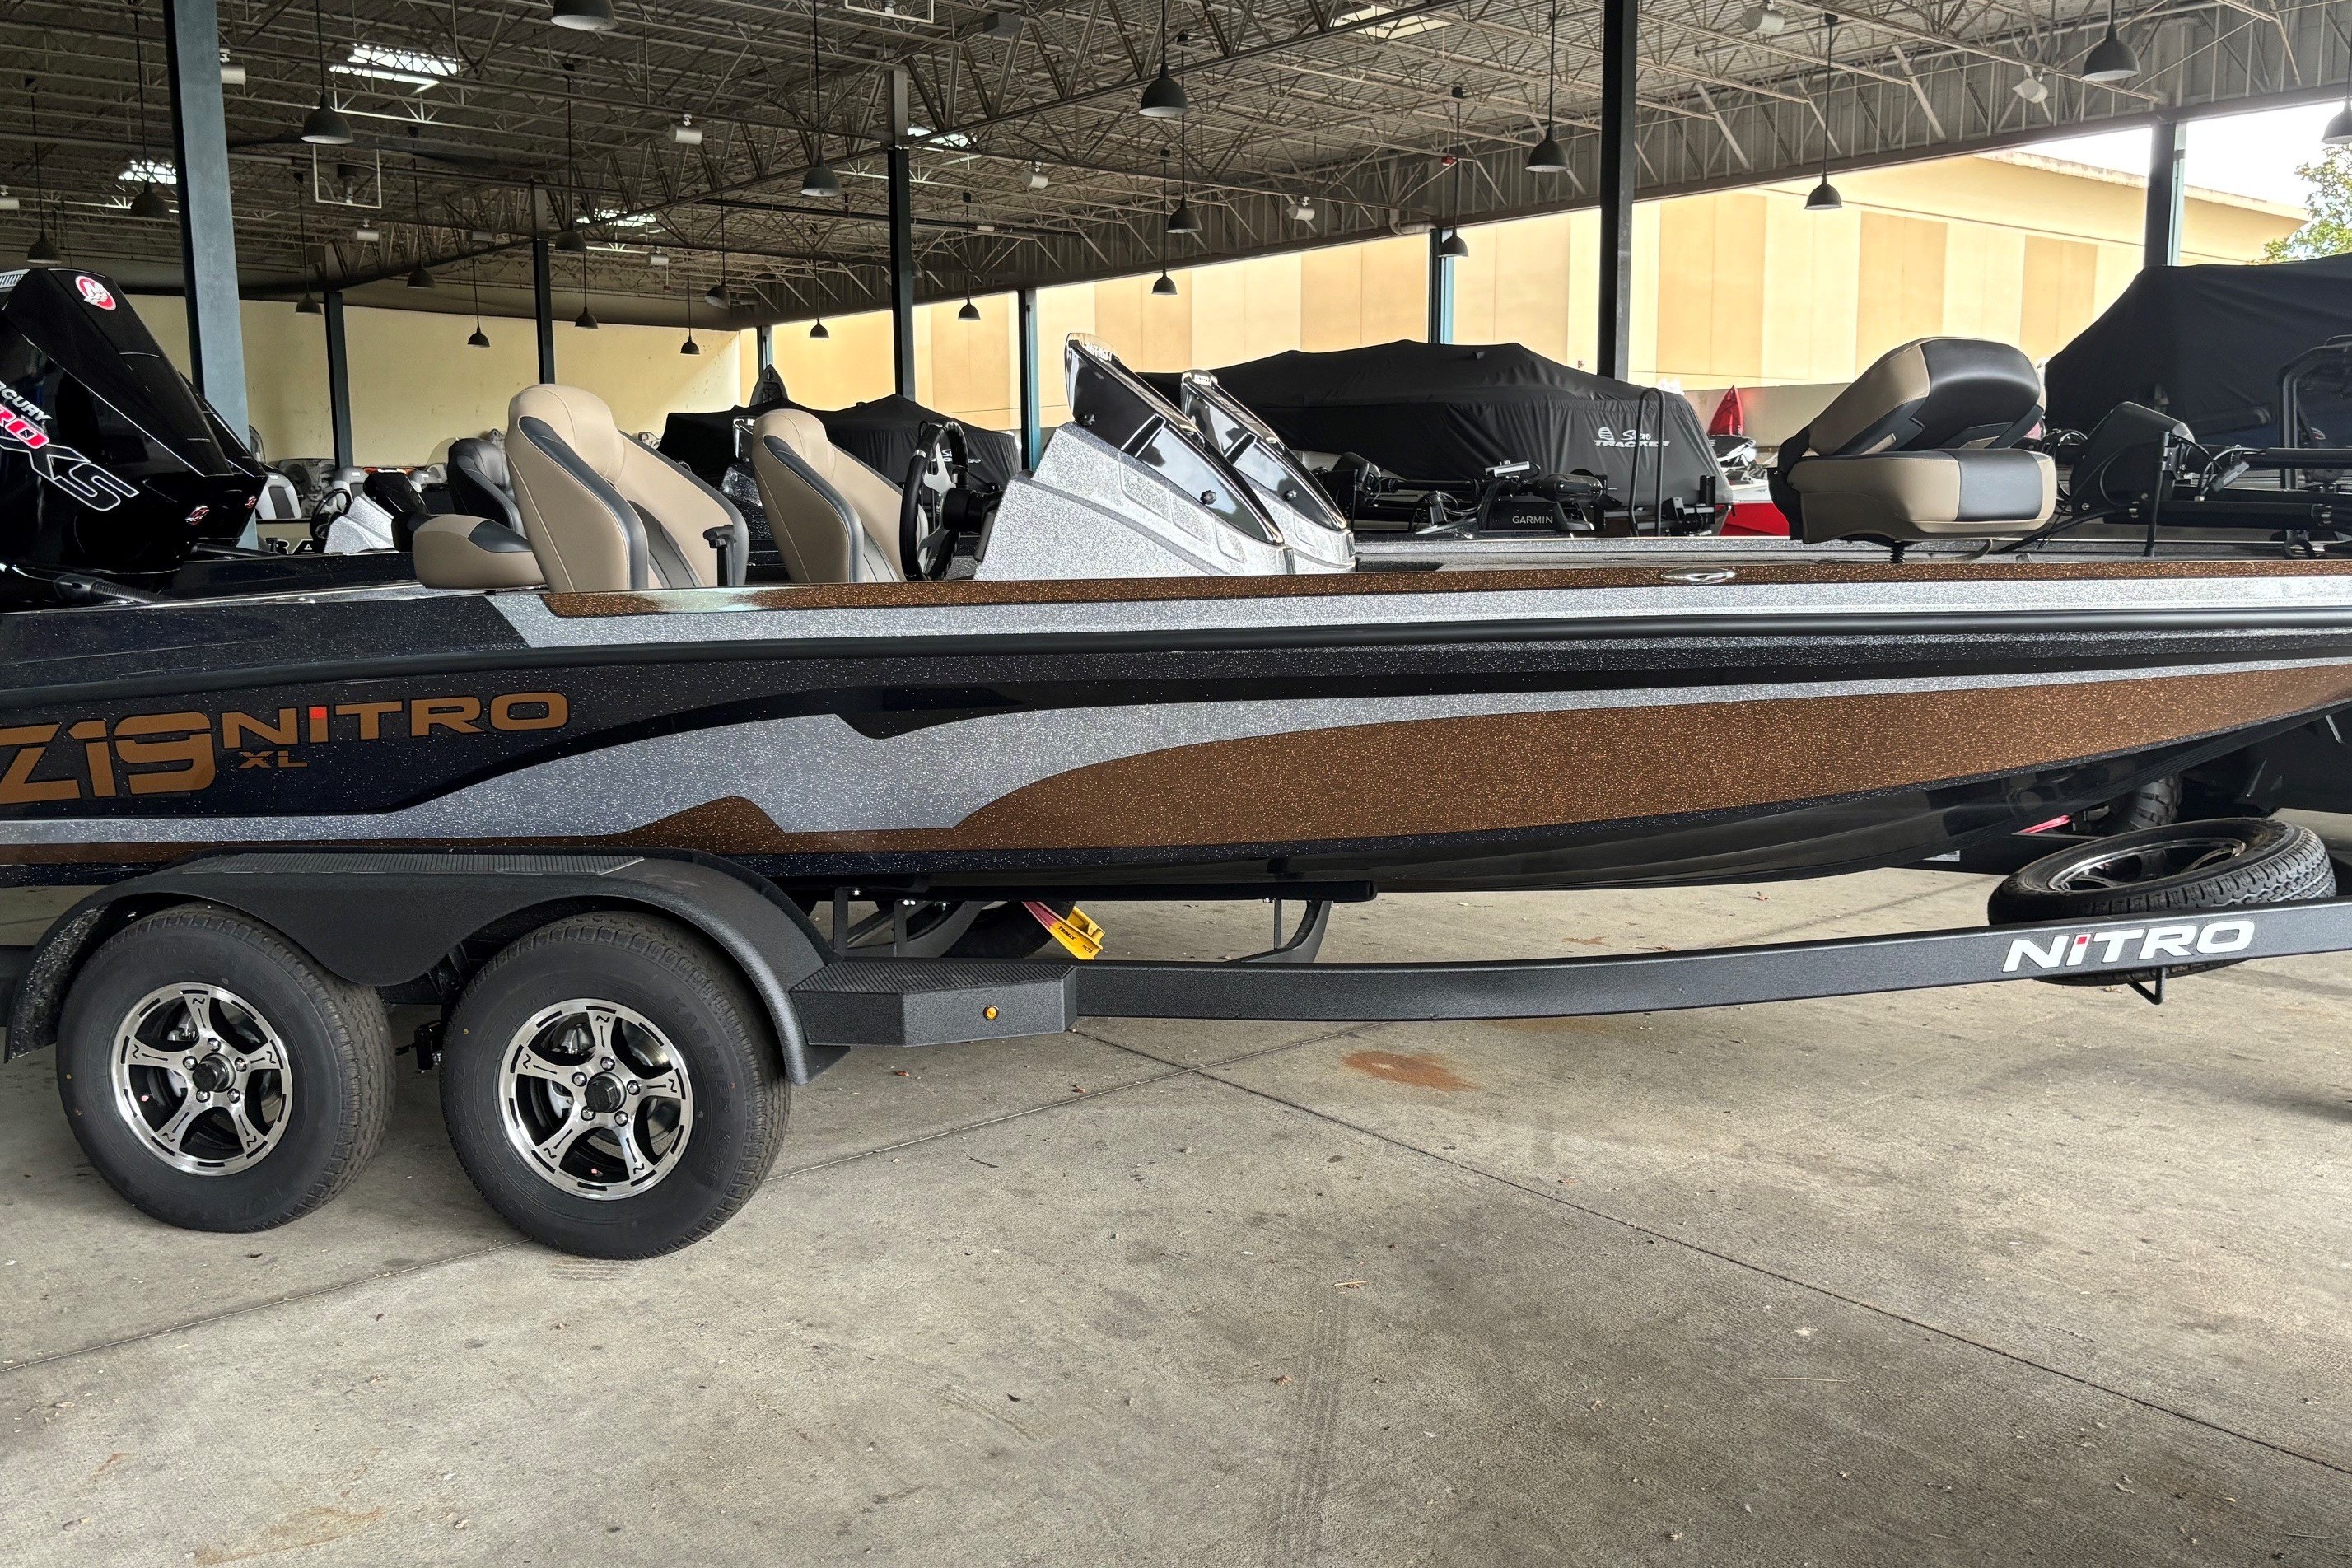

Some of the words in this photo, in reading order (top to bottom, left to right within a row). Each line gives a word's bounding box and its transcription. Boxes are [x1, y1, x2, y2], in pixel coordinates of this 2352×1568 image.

[1512, 516, 1553, 524] GARMIN
[222, 691, 569, 749] NITRO
[0, 711, 217, 805] Z19
[237, 750, 308, 768] XL
[2002, 920, 2256, 973] NITRO
